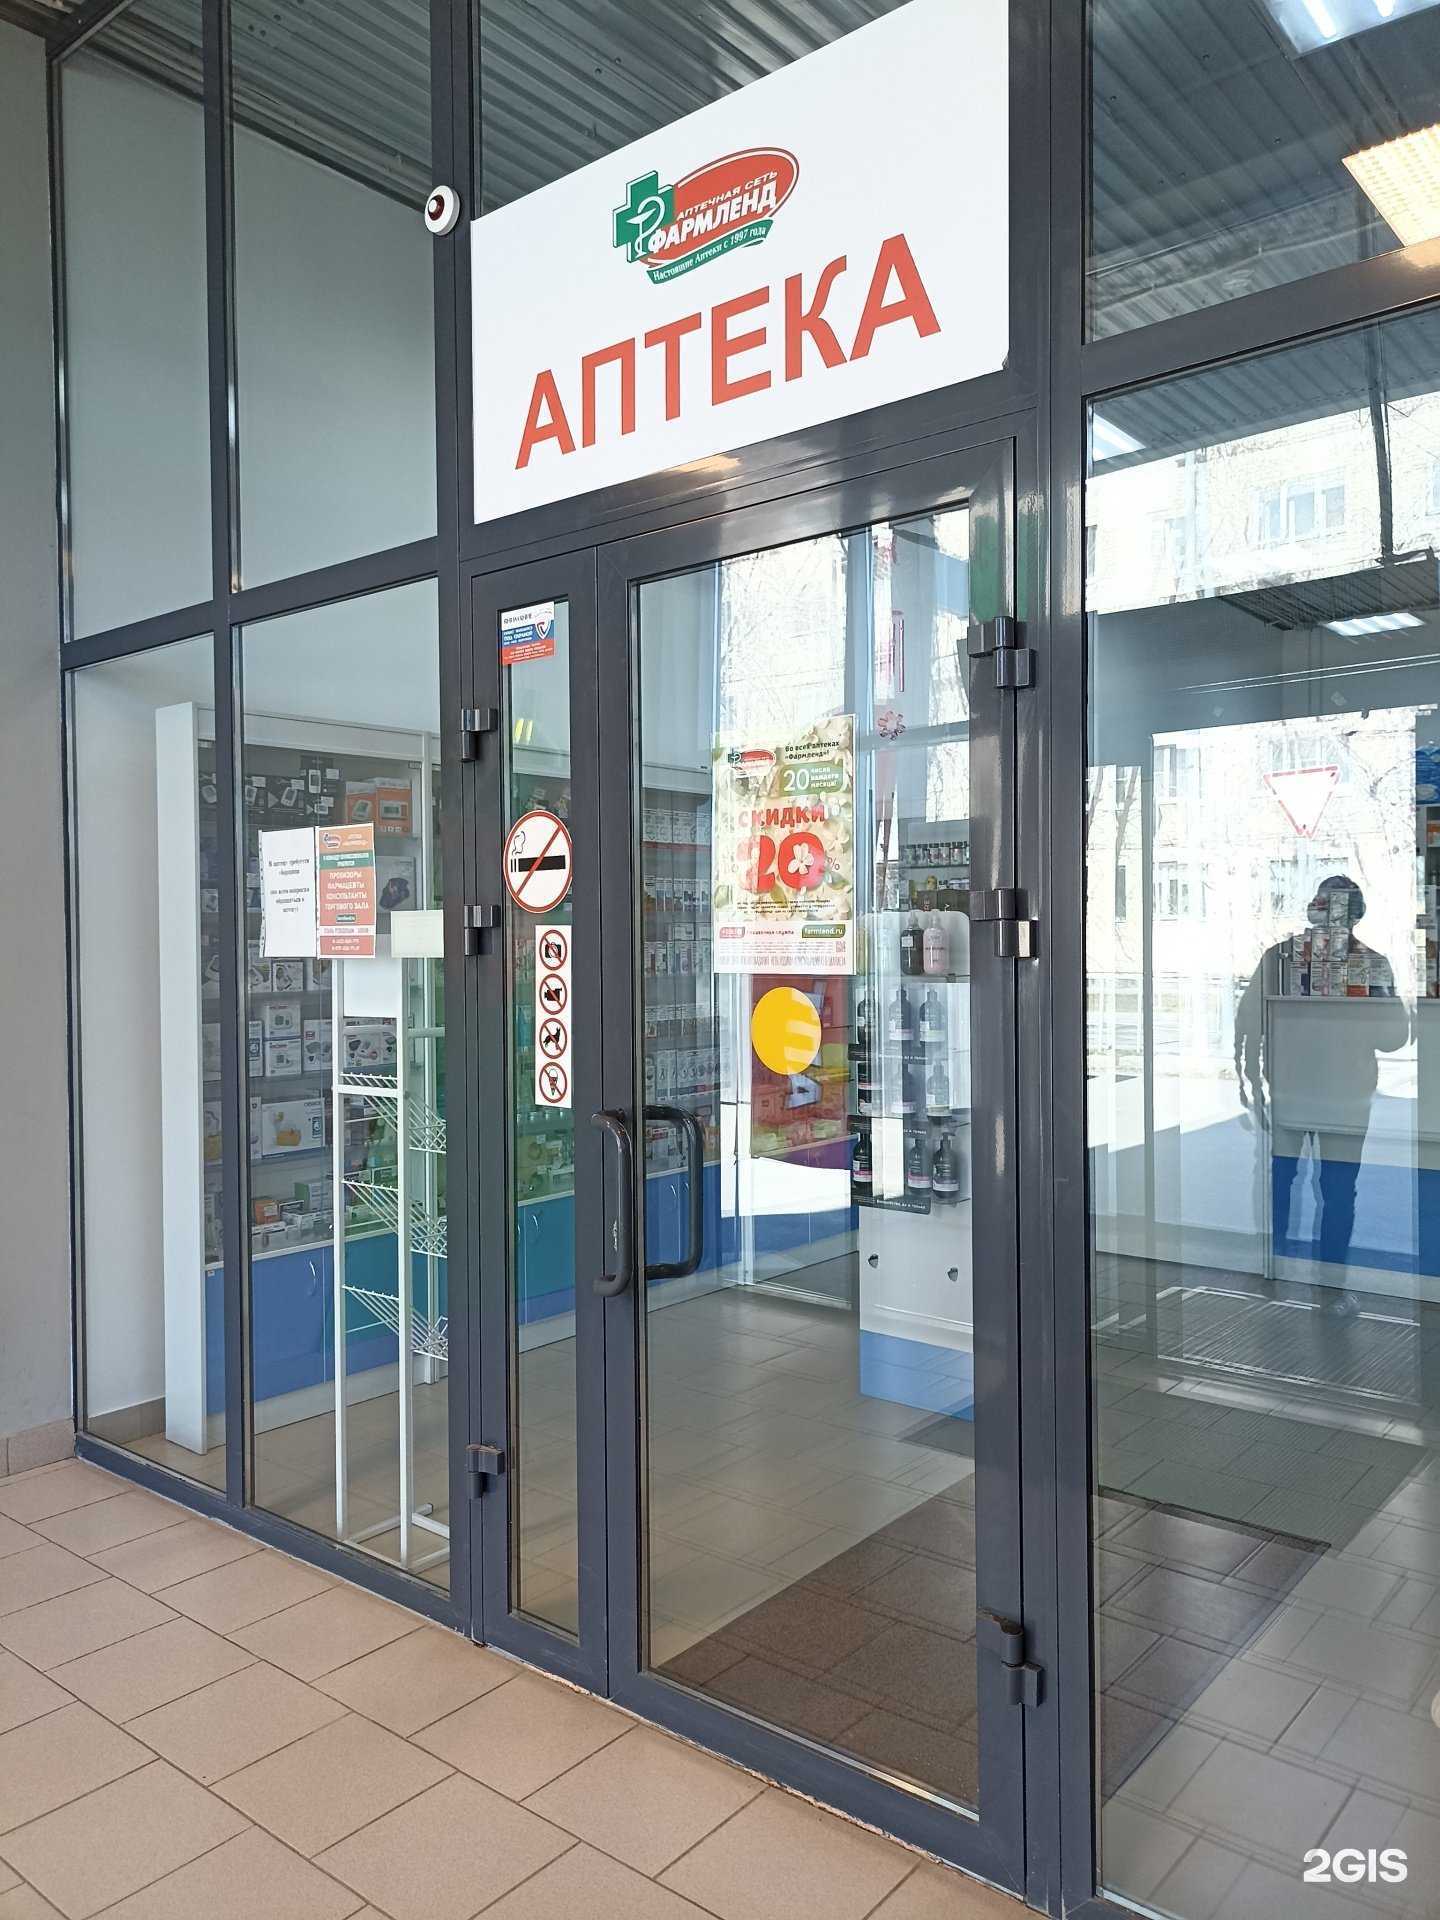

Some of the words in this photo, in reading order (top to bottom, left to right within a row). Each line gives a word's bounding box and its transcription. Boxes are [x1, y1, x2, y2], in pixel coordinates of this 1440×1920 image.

[647, 180, 778, 254] ФАРМЛЕНД
[676, 184, 742, 221] АПТЕЧНАЯ
[744, 170, 778, 191] СЕТЬ
[652, 260, 694, 281] Настоящие
[694, 243, 723, 265] Аптеки
[723, 239, 729, 249] с
[730, 228, 748, 246] 1997
[749, 226, 766, 238] года
[515, 232, 942, 470] АПТЕКА
[783, 768, 810, 791] 20
